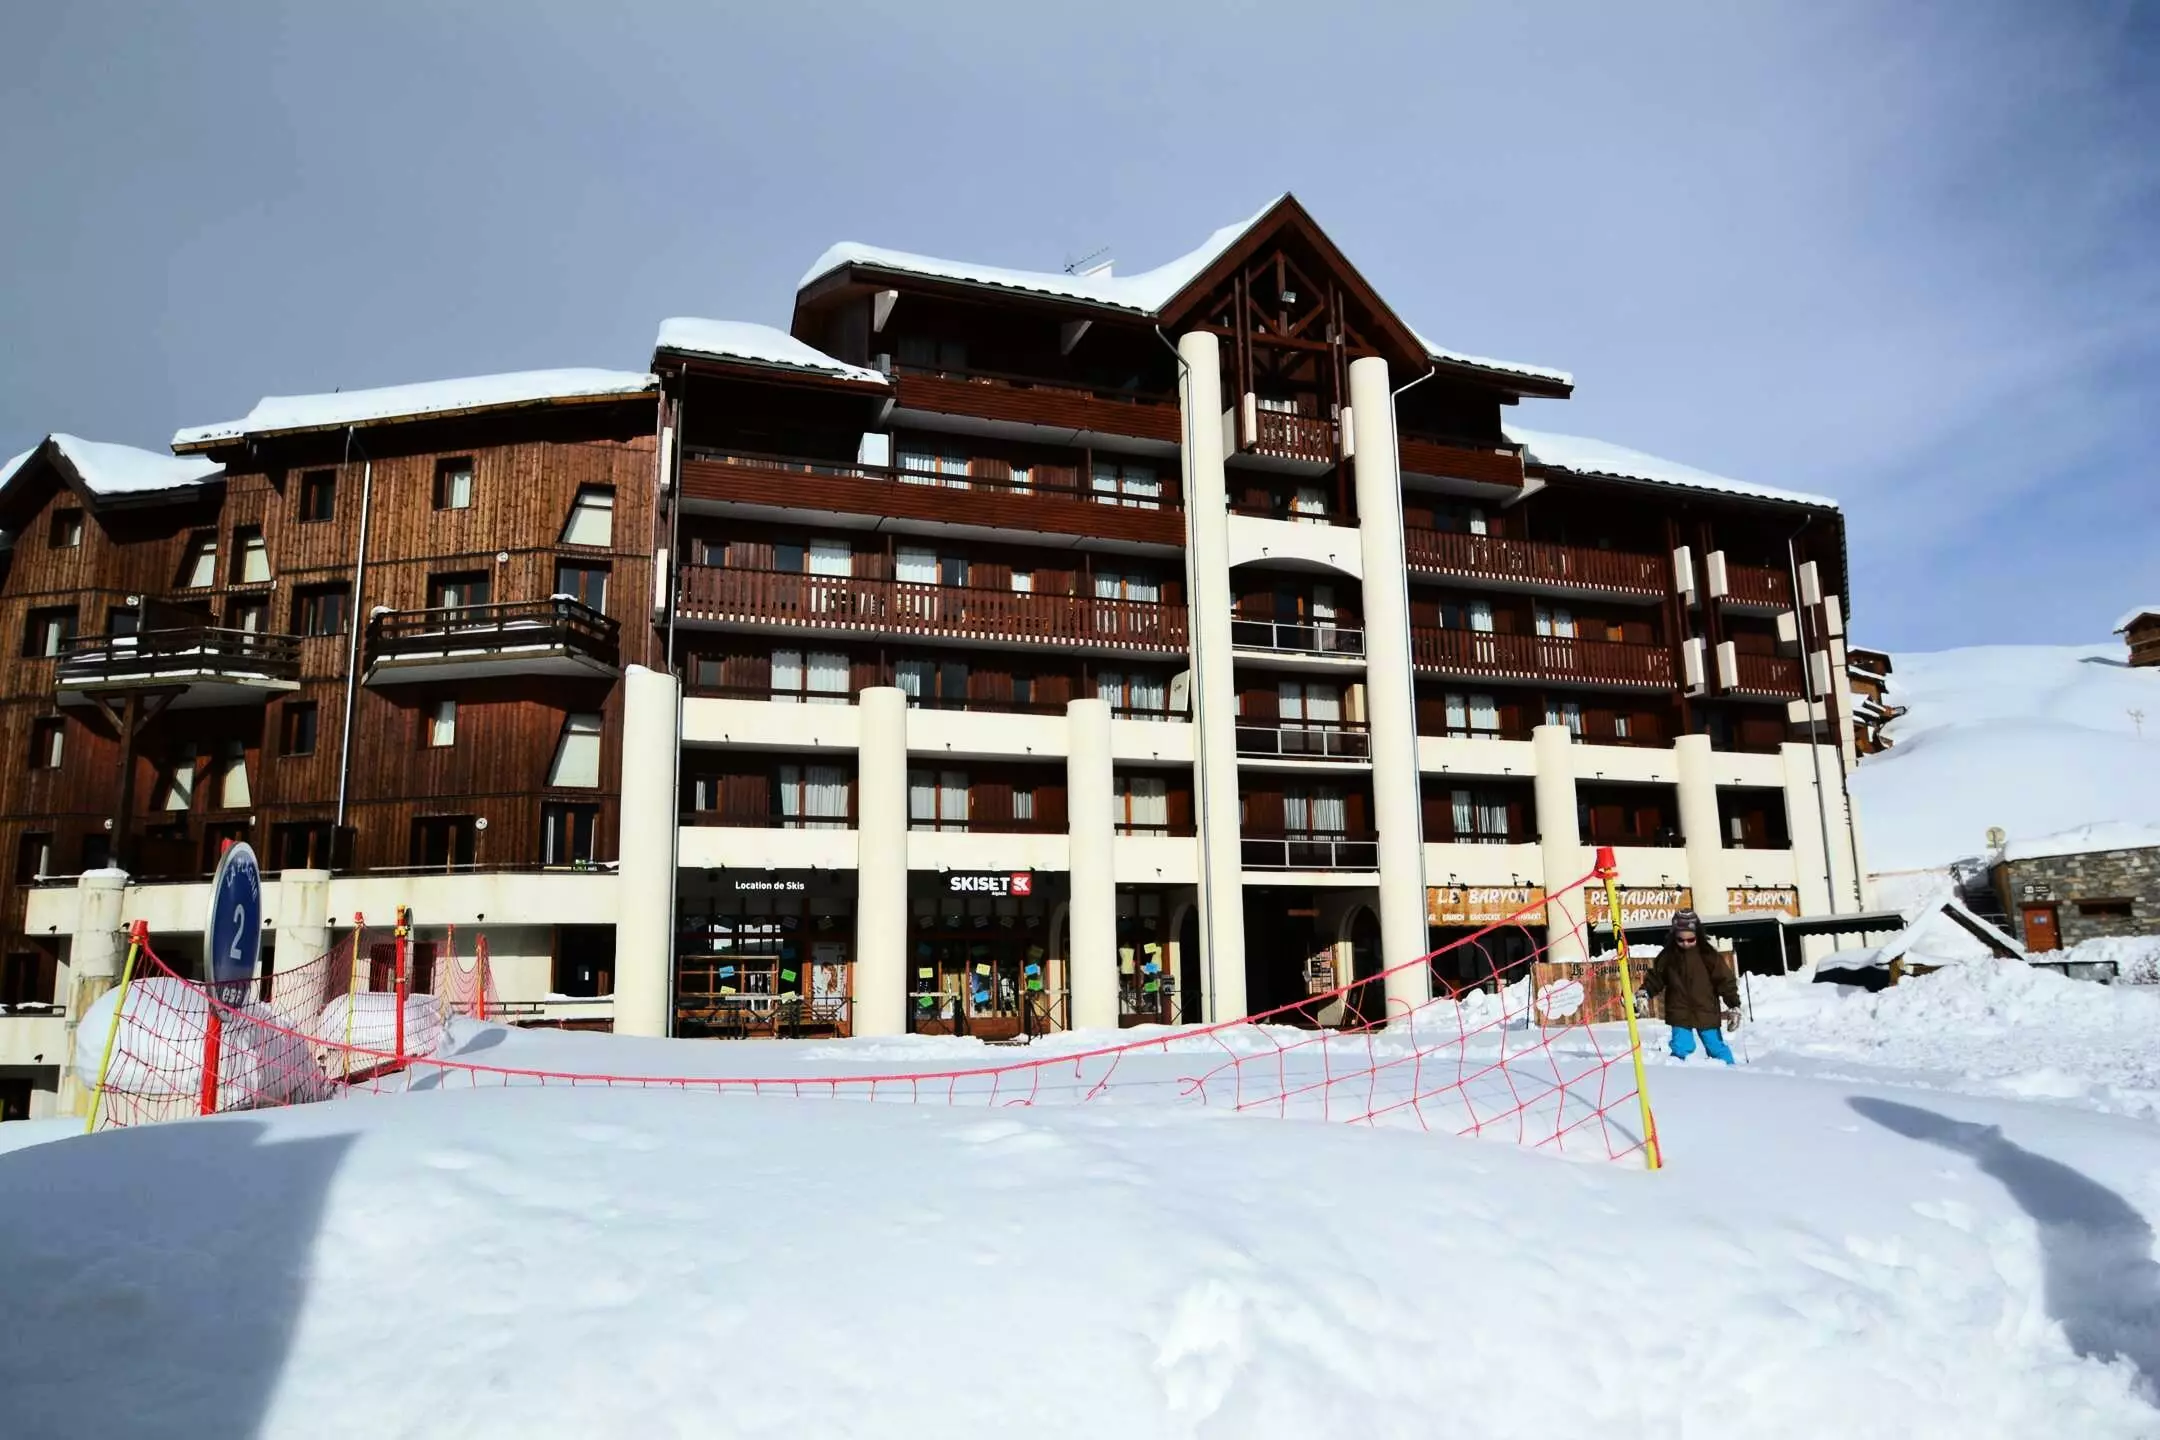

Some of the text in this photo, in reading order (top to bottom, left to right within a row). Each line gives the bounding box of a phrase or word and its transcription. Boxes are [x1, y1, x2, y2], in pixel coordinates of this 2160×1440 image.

[735, 881, 805, 890] Location de Skis
[950, 876, 1010, 891] SKISET
[1437, 888, 1530, 904] LE BARYON
[1591, 890, 1682, 905] RETAURANT
[230, 903, 245, 959] 2
